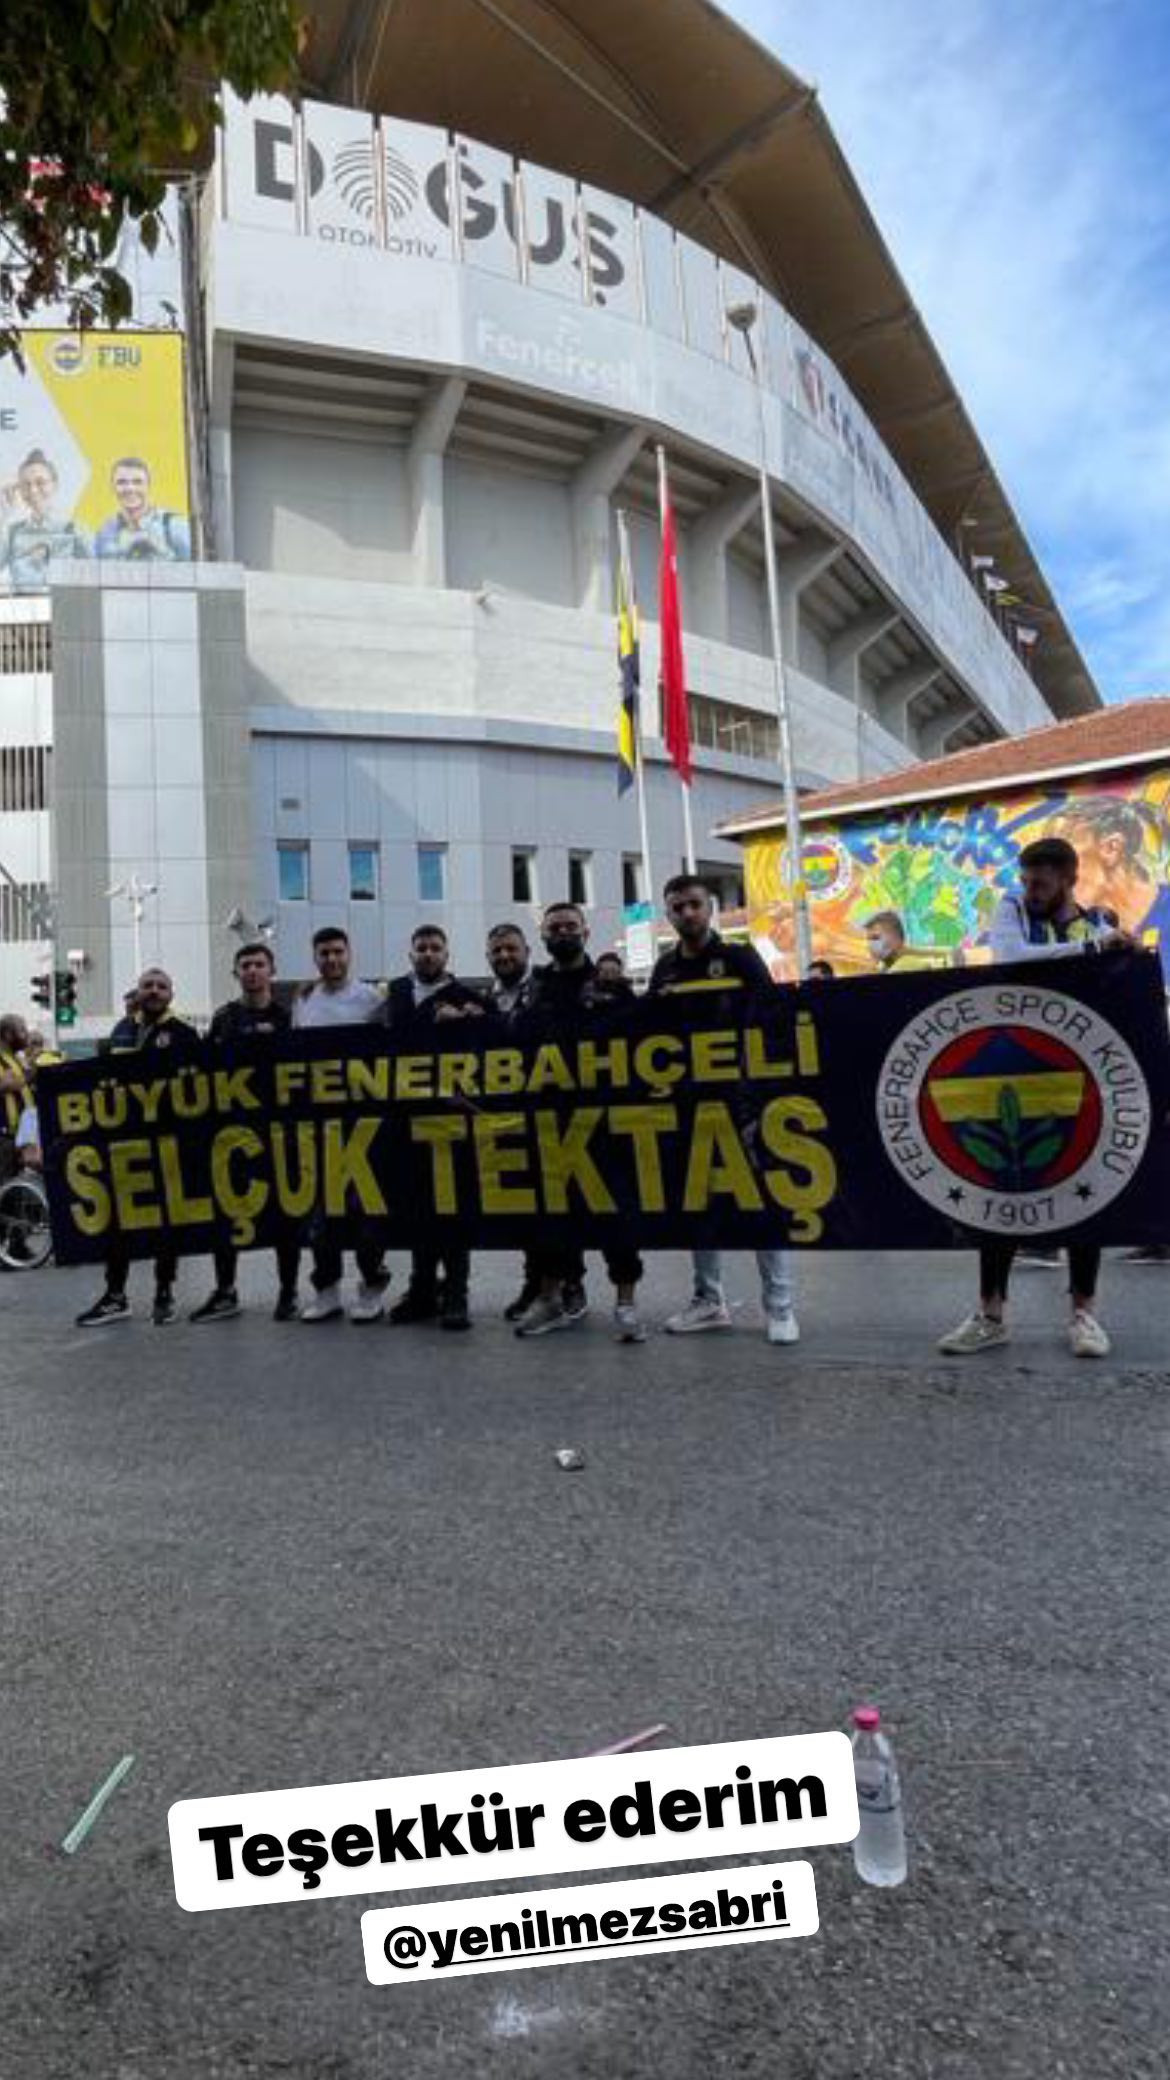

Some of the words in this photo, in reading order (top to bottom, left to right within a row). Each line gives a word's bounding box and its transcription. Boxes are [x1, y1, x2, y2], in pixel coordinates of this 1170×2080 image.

[56, 1065, 262, 1134] BÜYÜK
[275, 1011, 821, 1100] FENERBAHÇELİ
[883, 996, 980, 1182] FENERBAHÇE
[995, 990, 1094, 1042] SPOR
[65, 1117, 388, 1245] SELÇUK
[411, 1096, 839, 1243] TEKTAŞ
[981, 1197, 1057, 1227] 1907
